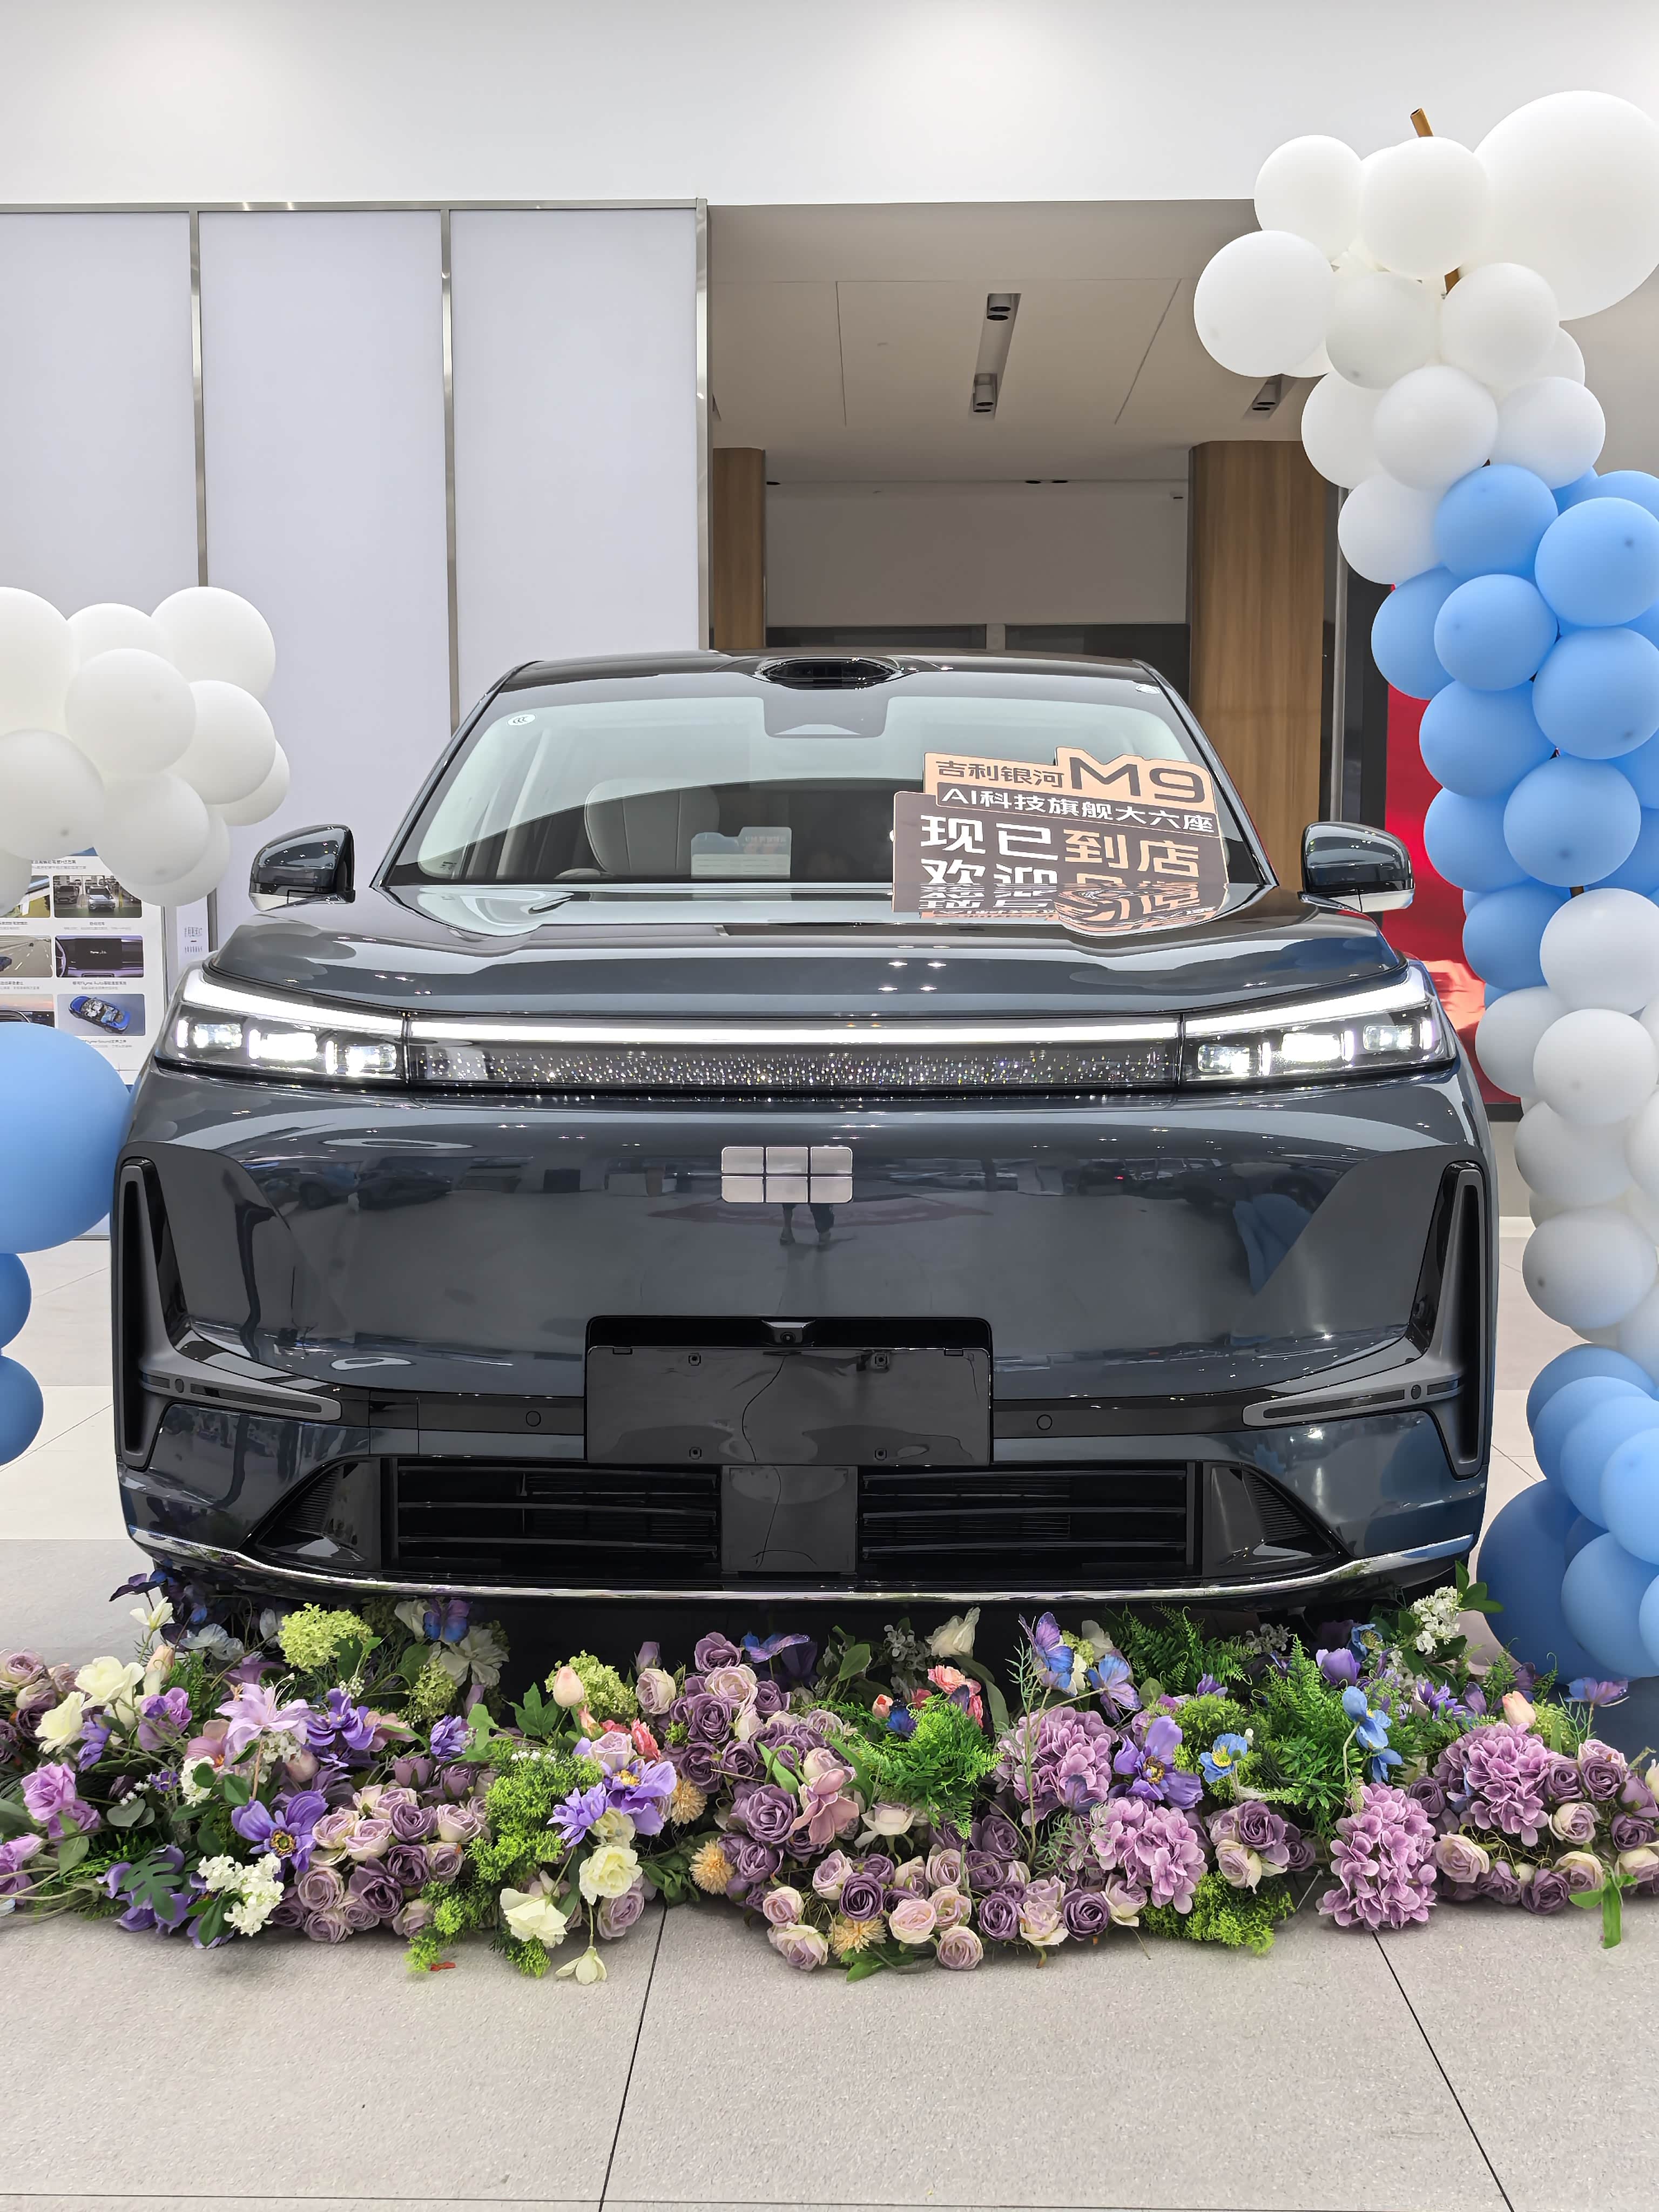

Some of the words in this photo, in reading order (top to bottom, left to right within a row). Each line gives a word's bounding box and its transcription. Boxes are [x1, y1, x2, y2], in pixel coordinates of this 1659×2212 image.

[936, 760, 1064, 788] 吉利银河
[1069, 757, 1205, 803] M9
[941, 788, 1215, 833] AI科技旗舰大六座
[920, 814, 1199, 878] 现已到店
